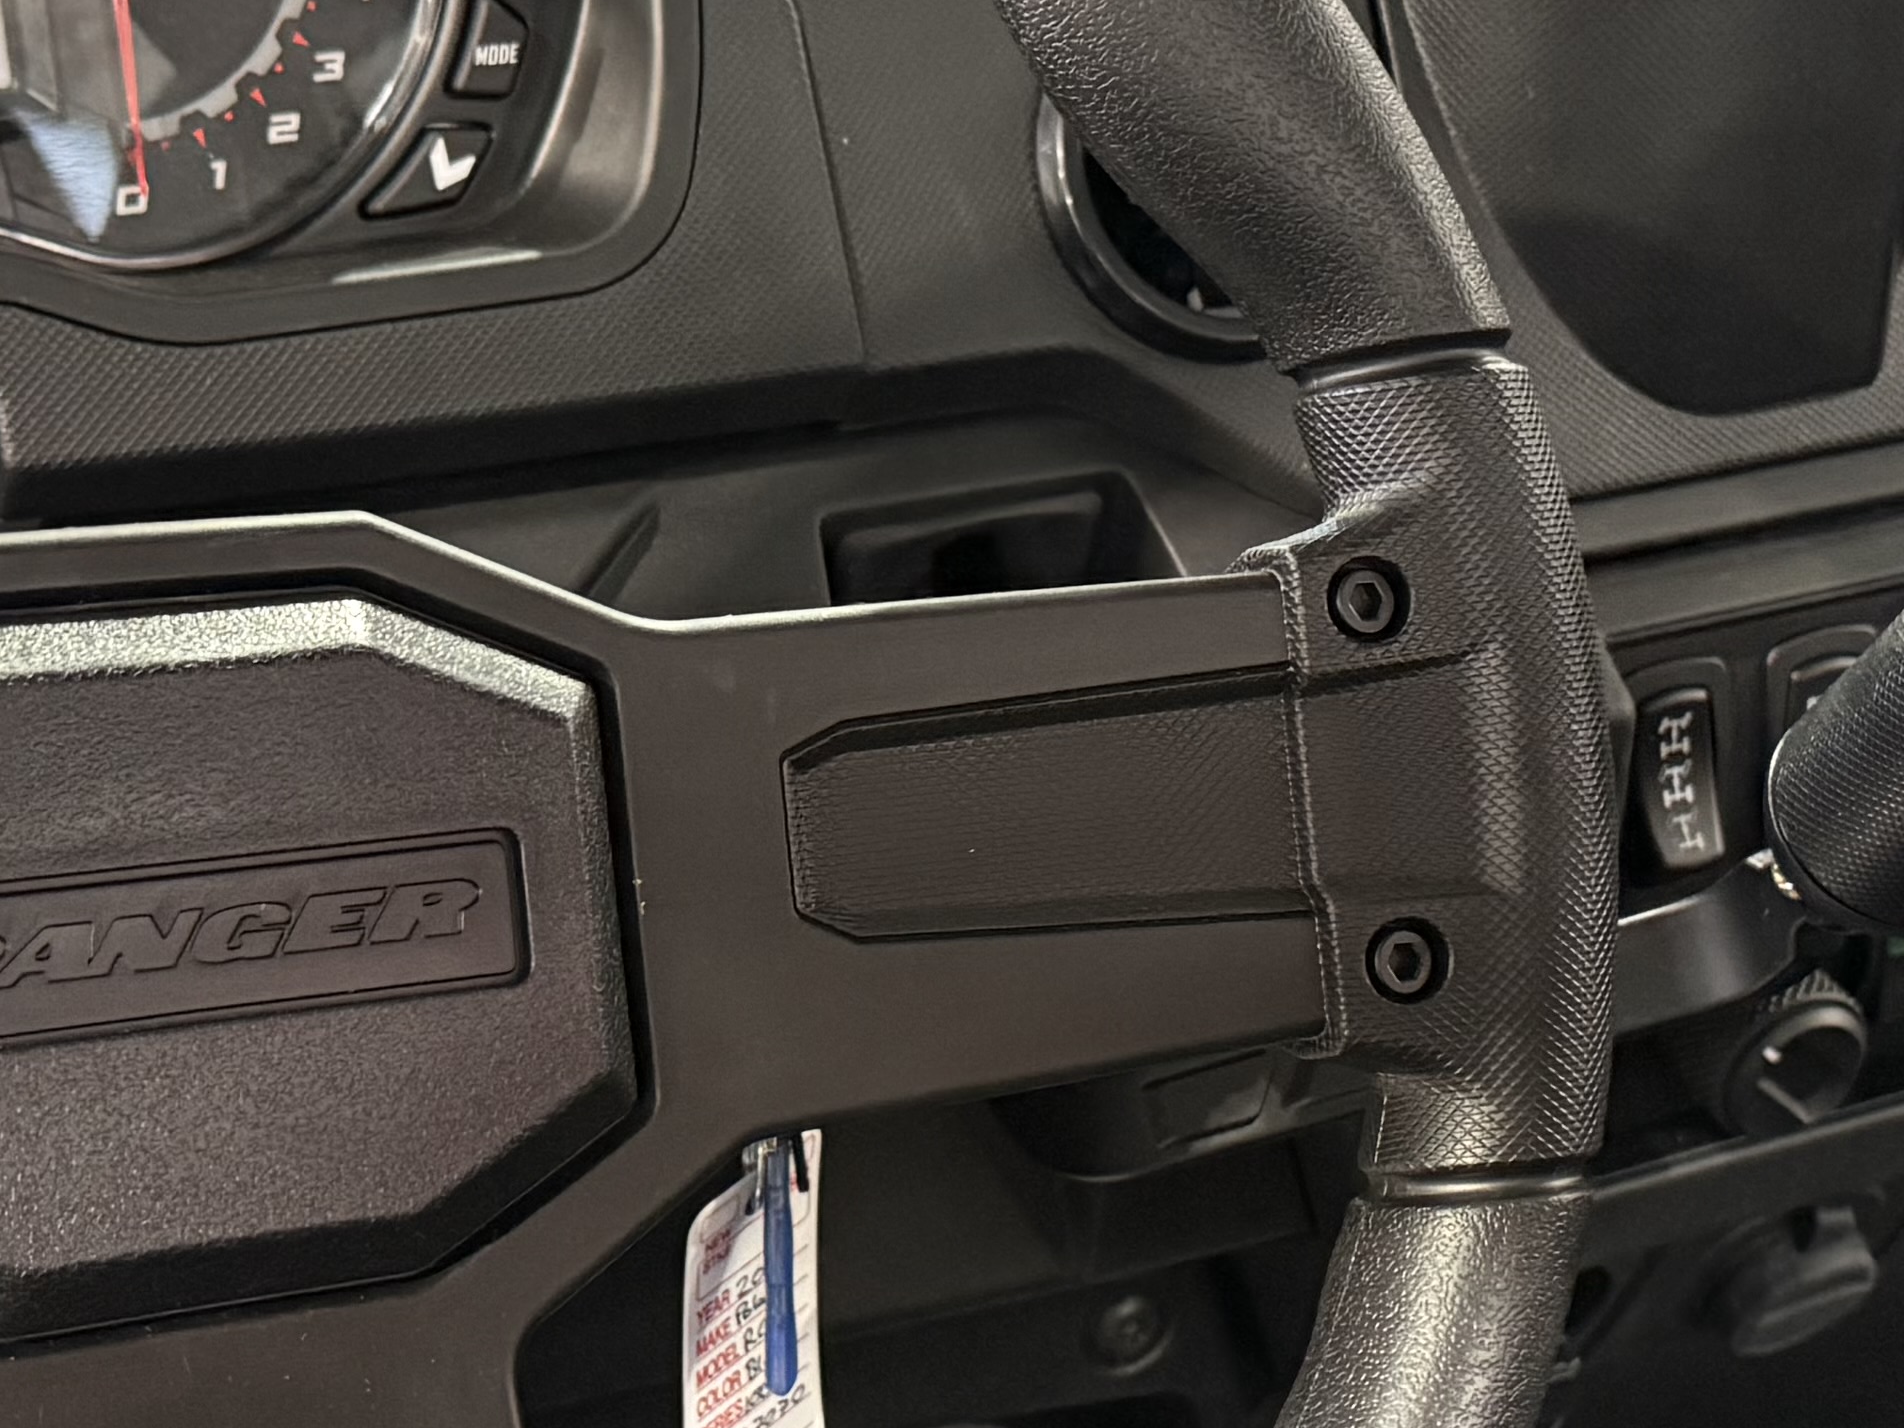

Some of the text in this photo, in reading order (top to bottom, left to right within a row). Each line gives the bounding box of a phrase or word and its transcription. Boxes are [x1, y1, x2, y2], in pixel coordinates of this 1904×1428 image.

[313, 50, 345, 82] 3
[475, 43, 520, 66] MODE
[267, 111, 300, 144] 2
[209, 160, 227, 190] 1
[116, 185, 149, 216] 0
[696, 1289, 730, 1326] YEAR
[696, 1316, 731, 1356] MAKE
[696, 1342, 742, 1388] MODEL
[697, 1370, 742, 1417] COLOR
